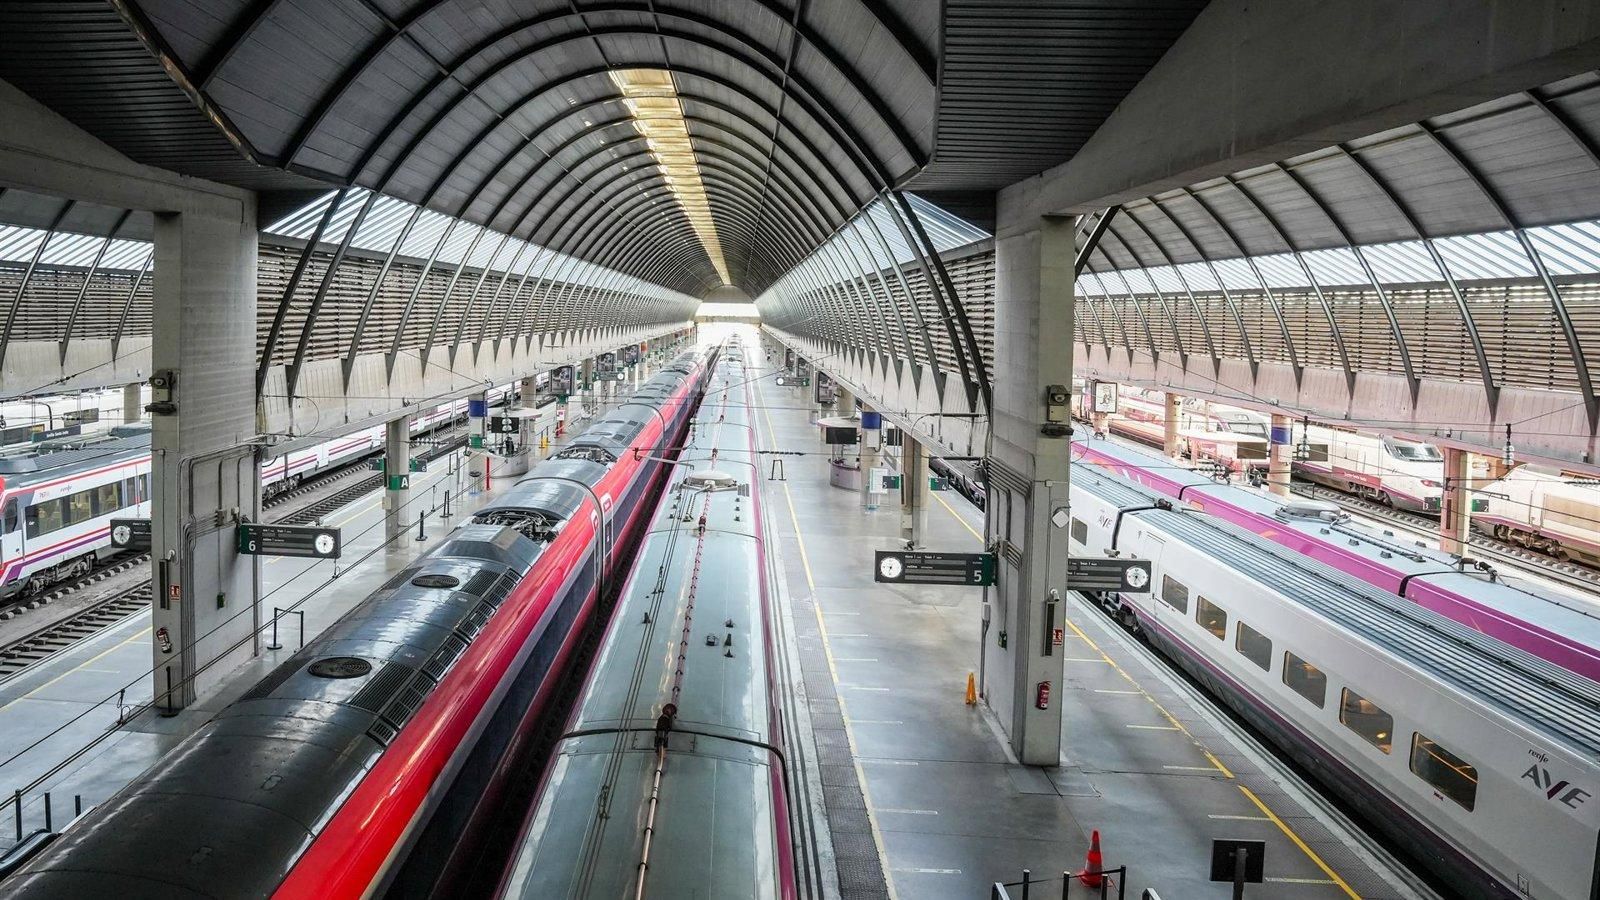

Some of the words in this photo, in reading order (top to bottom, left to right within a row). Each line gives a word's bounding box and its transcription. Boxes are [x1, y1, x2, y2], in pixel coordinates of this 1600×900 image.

[401, 477, 408, 488] A
[1099, 515, 1113, 528] AVE
[248, 540, 256, 552] 6
[973, 570, 982, 582] 5
[1528, 747, 1549, 763] renfe
[1520, 763, 1592, 810] AVE
